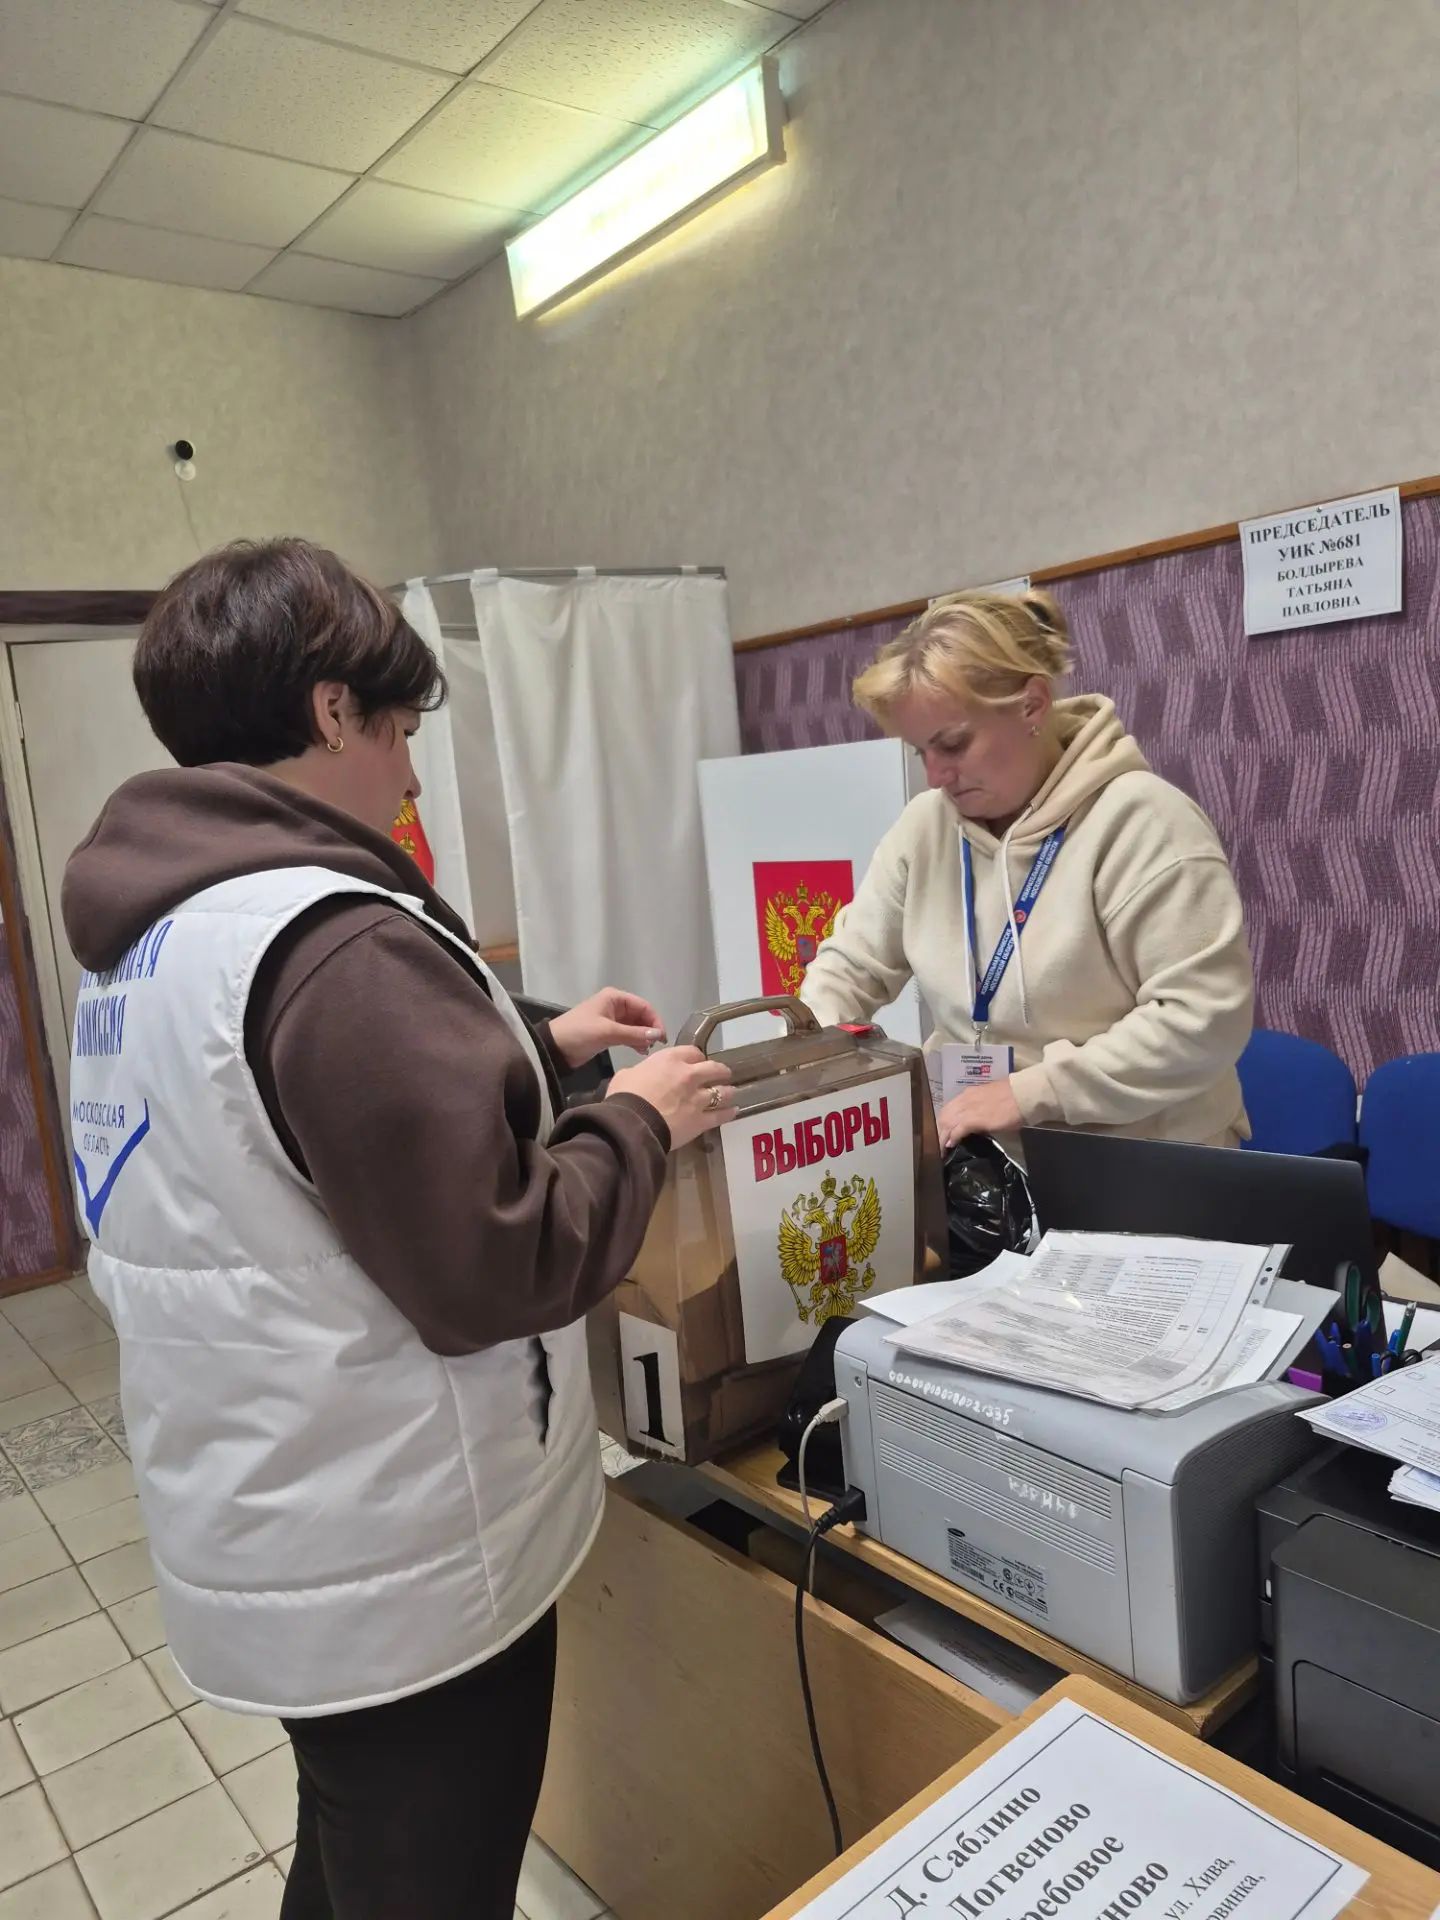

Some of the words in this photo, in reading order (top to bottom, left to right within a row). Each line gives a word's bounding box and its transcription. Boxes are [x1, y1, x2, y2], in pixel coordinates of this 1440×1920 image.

[1250, 503, 1391, 544] ПРЕДСЕДАТЕЛЬ
[1278, 542, 1315, 562] УИК
[1319, 533, 1361, 554] №681
[1277, 556, 1364, 582] БОЛДЫРЕВА
[1286, 577, 1353, 598] ТАТЬЯНА
[1282, 596, 1361, 617] ПАВЛОВНА
[752, 1096, 890, 1182] ВЫБОРЫ
[633, 1352, 675, 1447] 1
[884, 1885, 928, 1920] Д.
[922, 1787, 1041, 1883] Саблино
[945, 1803, 1091, 1920] Логвеново
[1095, 1862, 1168, 1920] ново
[1182, 1856, 1236, 1897] Хива,
